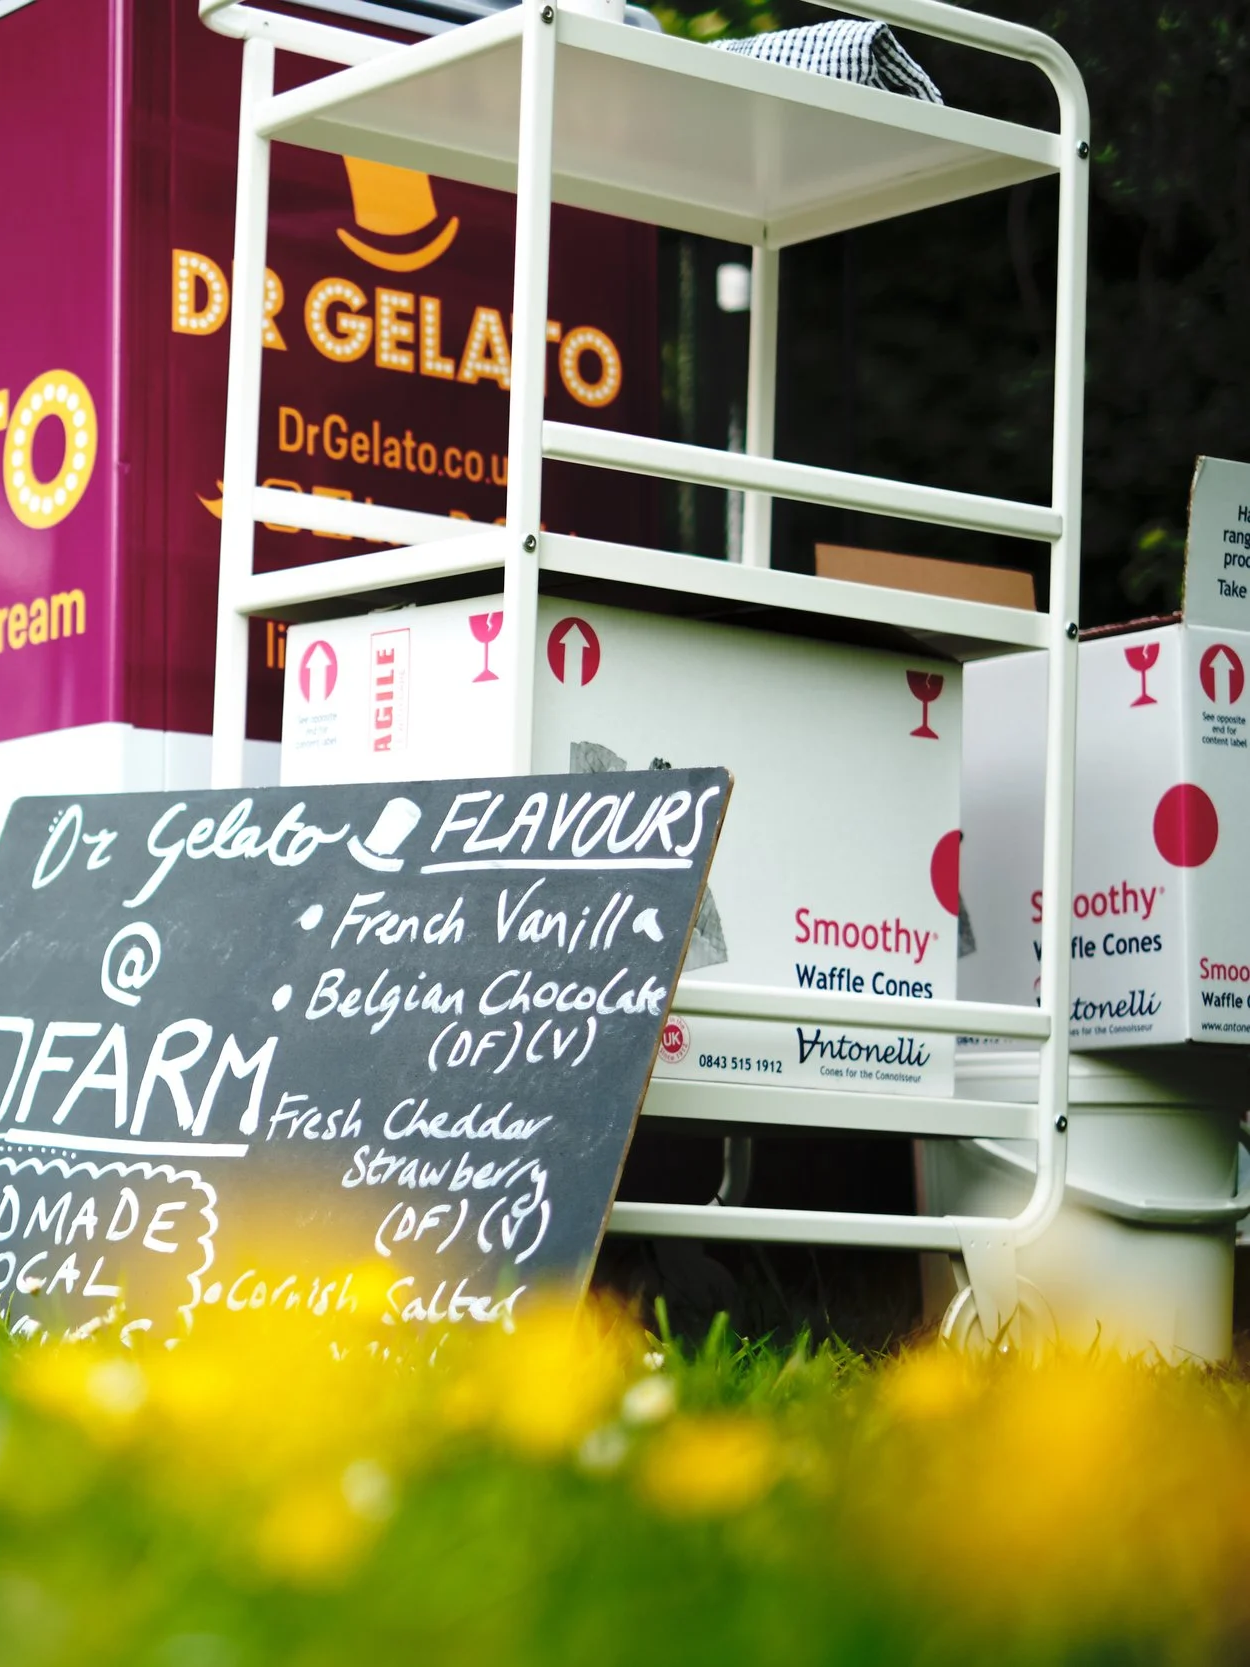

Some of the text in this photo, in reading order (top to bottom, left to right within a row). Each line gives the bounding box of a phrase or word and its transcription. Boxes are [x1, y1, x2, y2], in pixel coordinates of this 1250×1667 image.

[278, 406, 508, 487] DrGelato.co.u
[1217, 578, 1247, 599] Take
[1202, 711, 1247, 725] See opposite
[1212, 726, 1237, 736] end for
[1230, 738, 1248, 749] label
[430, 786, 721, 858] FLAVOURS
[31, 797, 350, 908] Dr Gelato
[331, 877, 664, 953] French Vanilla
[1030, 880, 1157, 925] Soothy
[99, 920, 162, 1007] @
[1033, 933, 1162, 962] fle Cones
[305, 967, 668, 1035] Belgian Chocolate
[795, 963, 933, 1000] Waffle Cones
[1201, 991, 1243, 1009] Waffle
[1036, 989, 1162, 1021] tonelli
[663, 1031, 681, 1047] UK
[796, 1027, 931, 1068] Antonelli
[15, 1017, 280, 1138] FARM
[699, 1054, 783, 1074] 0843 515 1912
[819, 1065, 843, 1077] Cones
[845, 1067, 857, 1078] for
[860, 1069, 873, 1079] the
[266, 1091, 553, 1142] Fresh Cheddar
[341, 1144, 550, 1219] Strawberry
[226, 1269, 528, 1335] Cornish Salted
